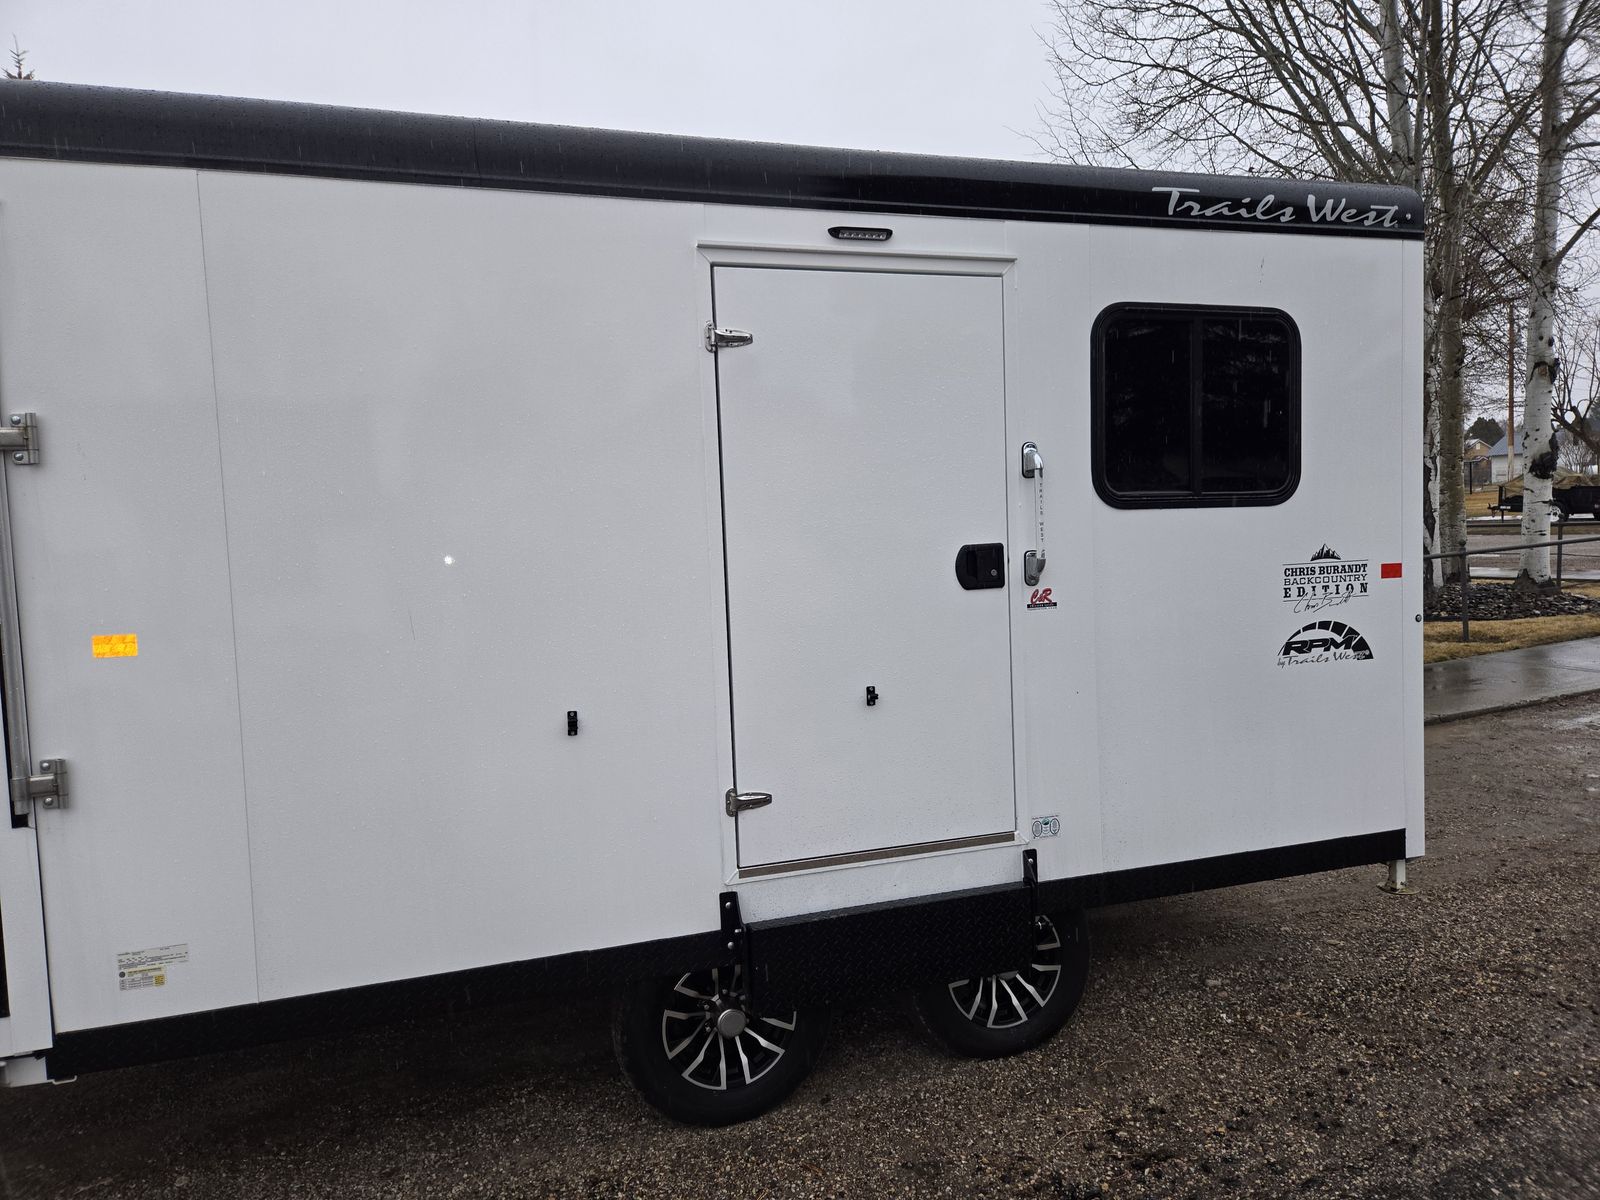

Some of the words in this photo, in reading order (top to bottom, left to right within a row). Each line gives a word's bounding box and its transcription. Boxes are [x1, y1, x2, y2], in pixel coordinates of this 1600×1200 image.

[1152, 187, 1296, 223] Trails
[1306, 194, 1399, 228] West
[1284, 566, 1317, 578] CHRIS
[1318, 563, 1368, 575] BURANDT
[1284, 574, 1368, 586] BACKCOUNTRY
[1283, 583, 1368, 598] EDITION
[1282, 635, 1357, 656] RPM
[1277, 657, 1286, 668] by
[1283, 653, 1329, 666] Trails
